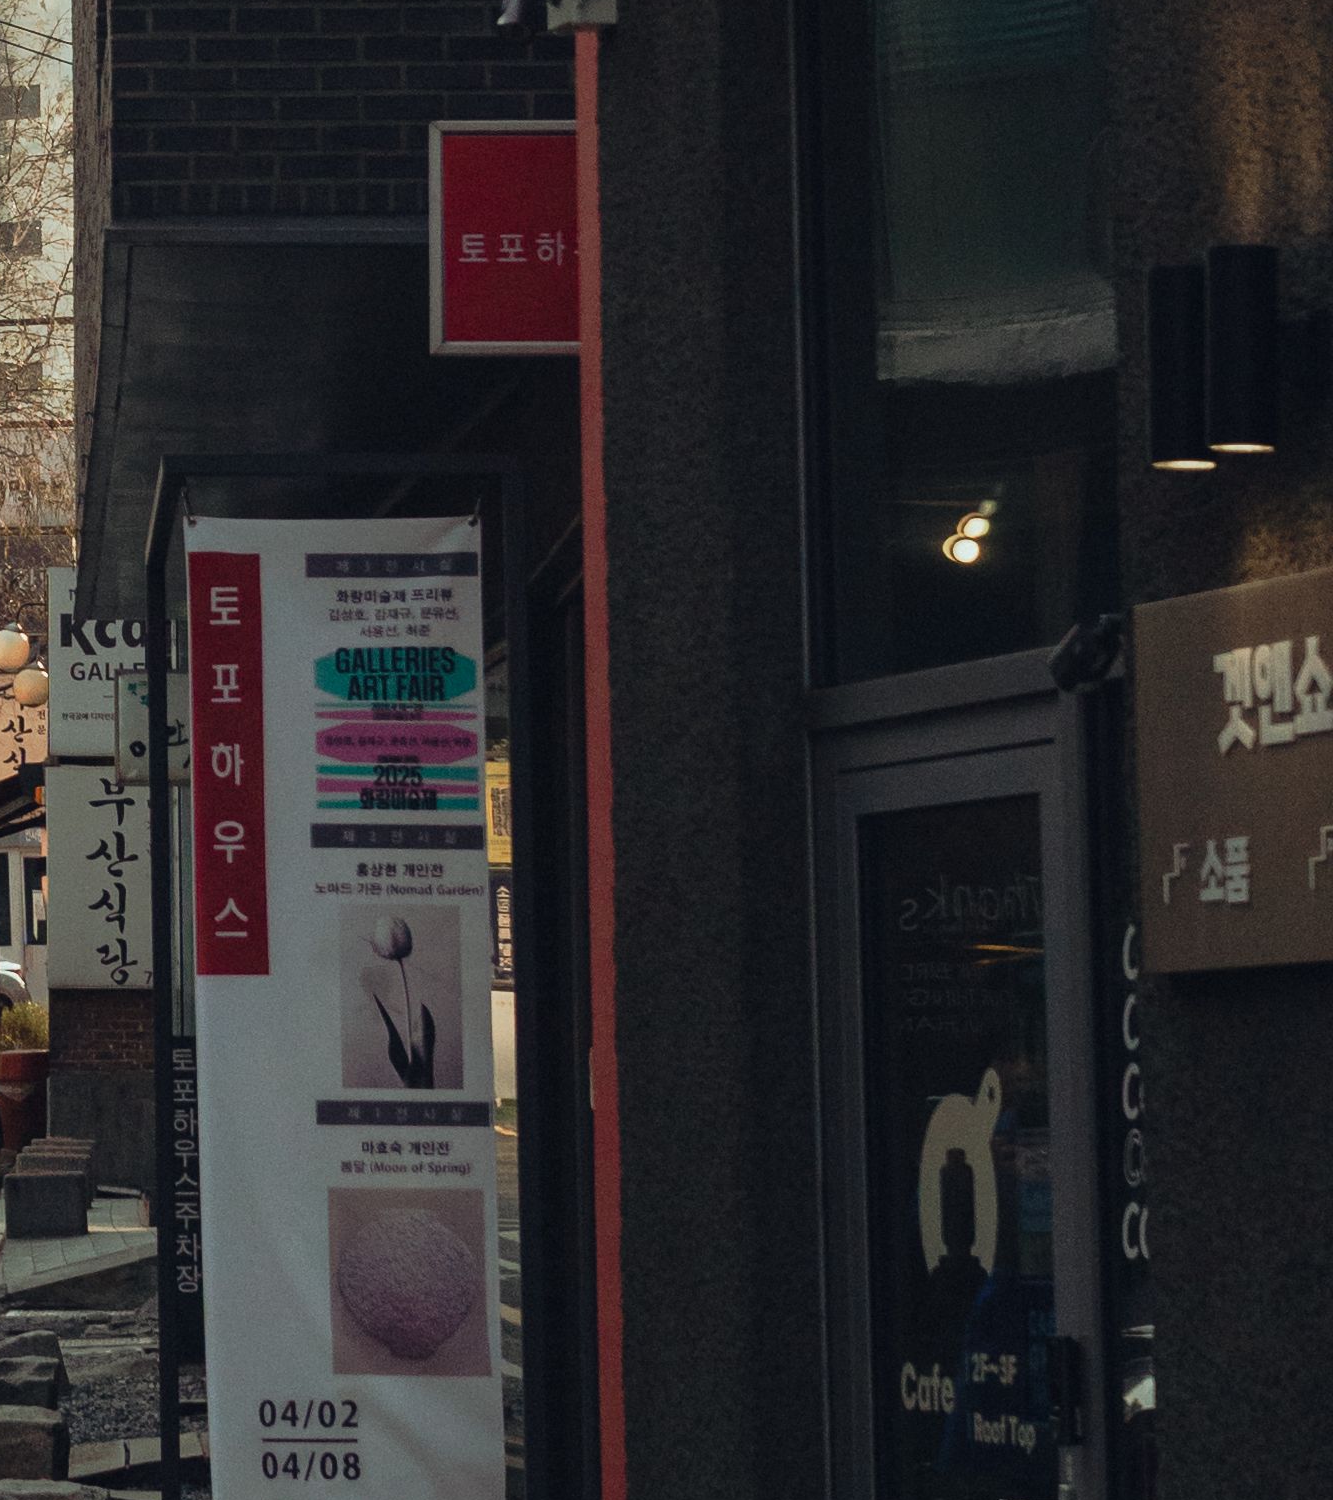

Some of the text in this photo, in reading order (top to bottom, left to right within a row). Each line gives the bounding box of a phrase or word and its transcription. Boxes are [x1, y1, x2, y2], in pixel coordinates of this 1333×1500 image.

[458, 231, 580, 268] 토포하
[334, 646, 456, 674] GALLERIES
[347, 674, 446, 701] ART FAIR
[208, 585, 248, 938] 토포하우스
[372, 765, 424, 788] 2025
[402, 862, 445, 878] 개인전
[314, 881, 353, 896] 노마드
[386, 882, 432, 897] (Nomad
[435, 883, 485, 898] Garden)
[408, 1140, 451, 1157] 개인전
[171, 1047, 201, 1294] 토포하우스주차장
[369, 1160, 408, 1175] (Moon
[411, 1160, 424, 1174] of
[427, 1161, 472, 1177] Spring)
[900, 1360, 956, 1415] Cafe
[258, 1399, 359, 1430] 04/02
[1008, 1413, 1037, 1455] Top
[261, 1451, 362, 1482] 04/08
